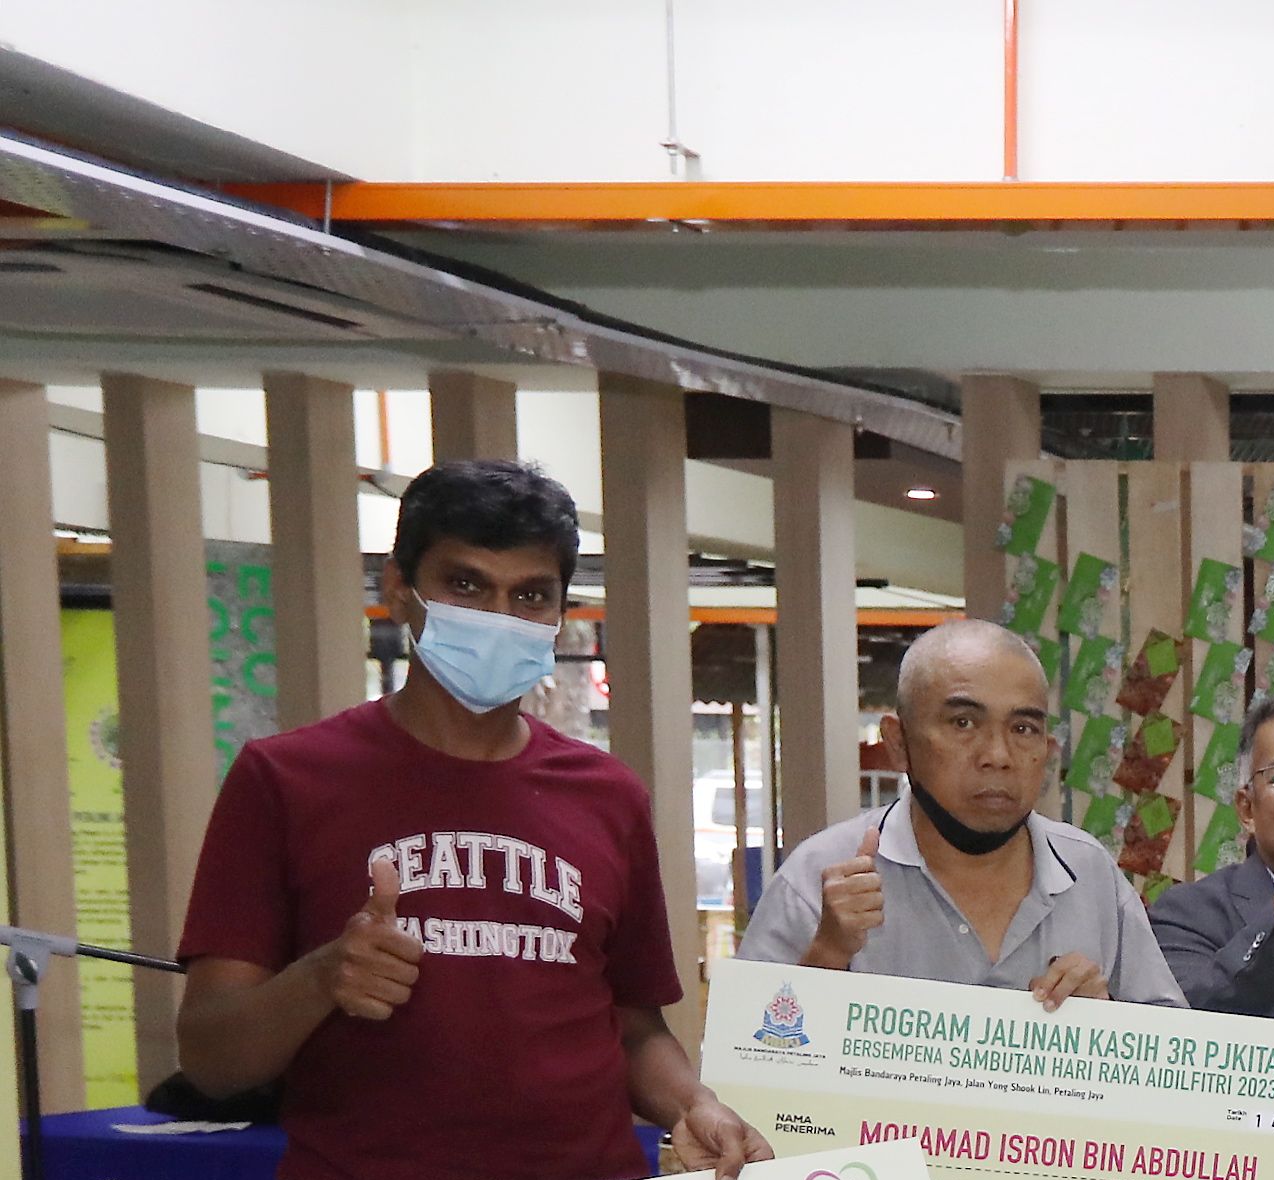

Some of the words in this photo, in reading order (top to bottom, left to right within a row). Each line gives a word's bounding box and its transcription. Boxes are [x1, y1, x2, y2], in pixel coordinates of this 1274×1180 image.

[397, 916, 578, 964] ASHINGTON
[846, 1002, 970, 1043] PROGRAM
[976, 1017, 1080, 1054] JALINAN
[1088, 1028, 1159, 1062] KASIH
[1166, 1037, 1196, 1066] 3R
[842, 1037, 942, 1064] BERSEMPENA
[949, 1046, 1046, 1076] SAMBUTAN
[1051, 1056, 1092, 1080] HARI
[1098, 1061, 1139, 1085] RAYA
[1144, 1067, 1232, 1094] AIDILFITRI
[775, 1113, 811, 1123] NAMA
[775, 1122, 835, 1135] PENERIMA
[999, 1133, 1075, 1167] ISRON
[1083, 1141, 1124, 1172] BIN
